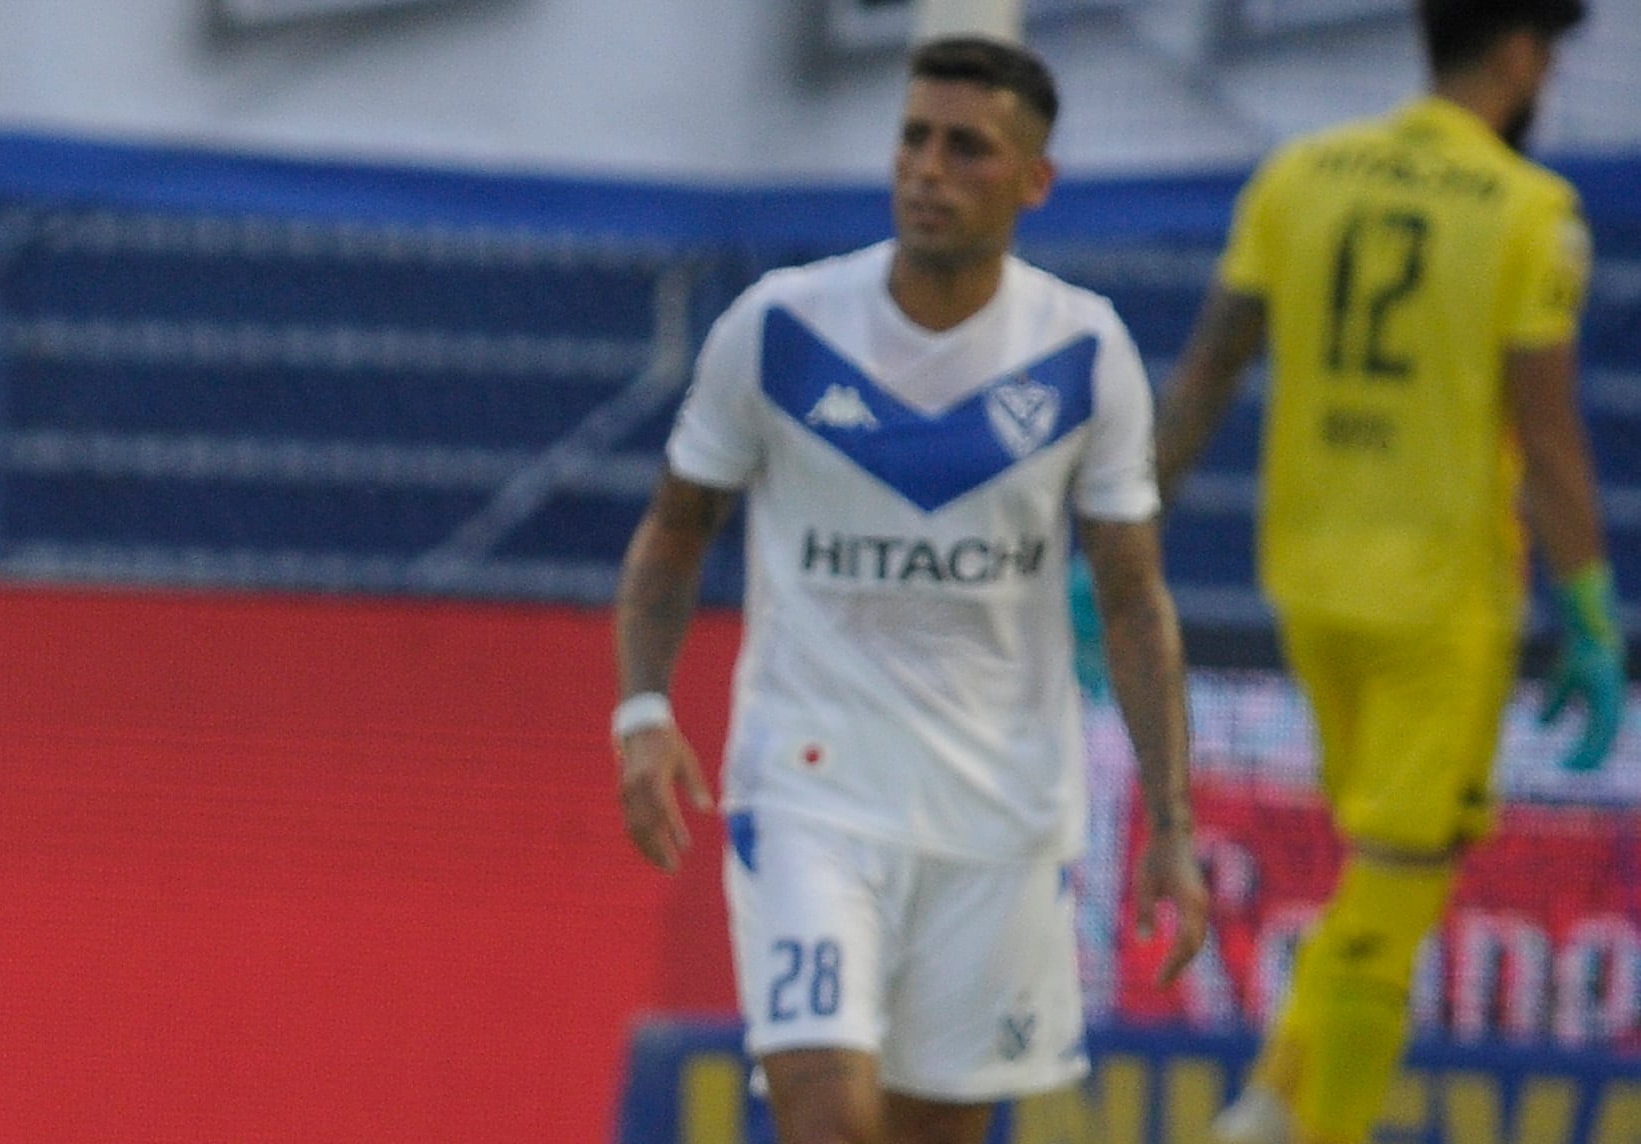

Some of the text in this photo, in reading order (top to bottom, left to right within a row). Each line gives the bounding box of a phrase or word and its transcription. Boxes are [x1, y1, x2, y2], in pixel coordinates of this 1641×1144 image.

[1323, 205, 1431, 379] 12
[801, 529, 1046, 584] HITACHI
[769, 936, 841, 1023] 28
